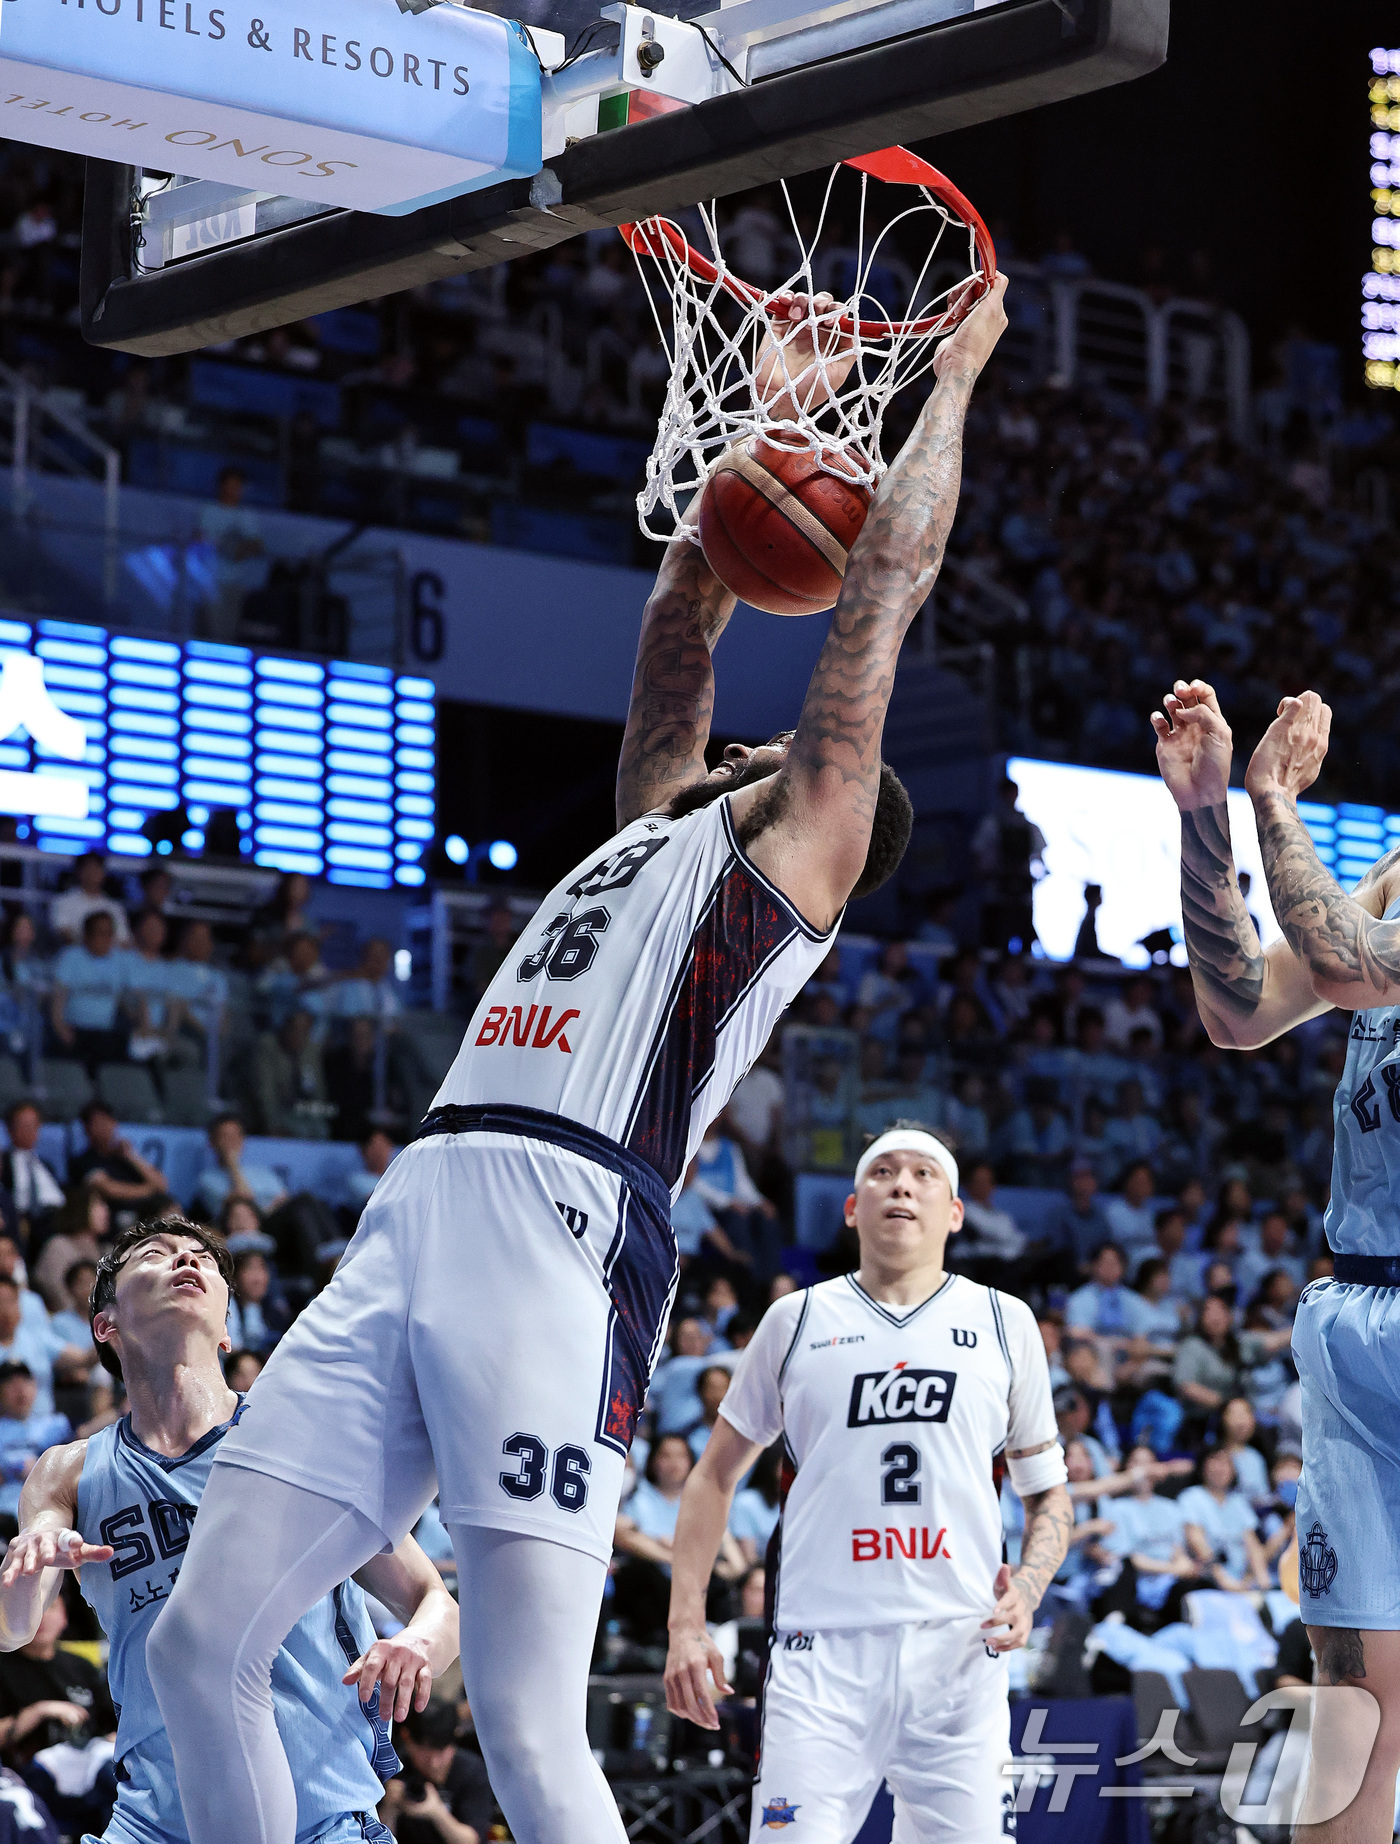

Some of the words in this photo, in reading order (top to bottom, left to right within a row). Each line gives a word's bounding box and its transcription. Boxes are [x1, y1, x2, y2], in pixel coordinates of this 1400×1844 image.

[247, 18, 273, 51] &
[293, 27, 470, 95] RESORTS
[0, 91, 148, 130] HOTEL
[164, 130, 358, 177] SONO
[411, 570, 445, 662] 6
[516, 905, 612, 982] 36
[475, 1004, 581, 1053] BNK
[857, 1361, 948, 1421] KCC
[499, 1431, 592, 1513] 36
[880, 1440, 922, 1506] 2
[100, 1499, 198, 1581] SO
[852, 1527, 952, 1561] BNK
